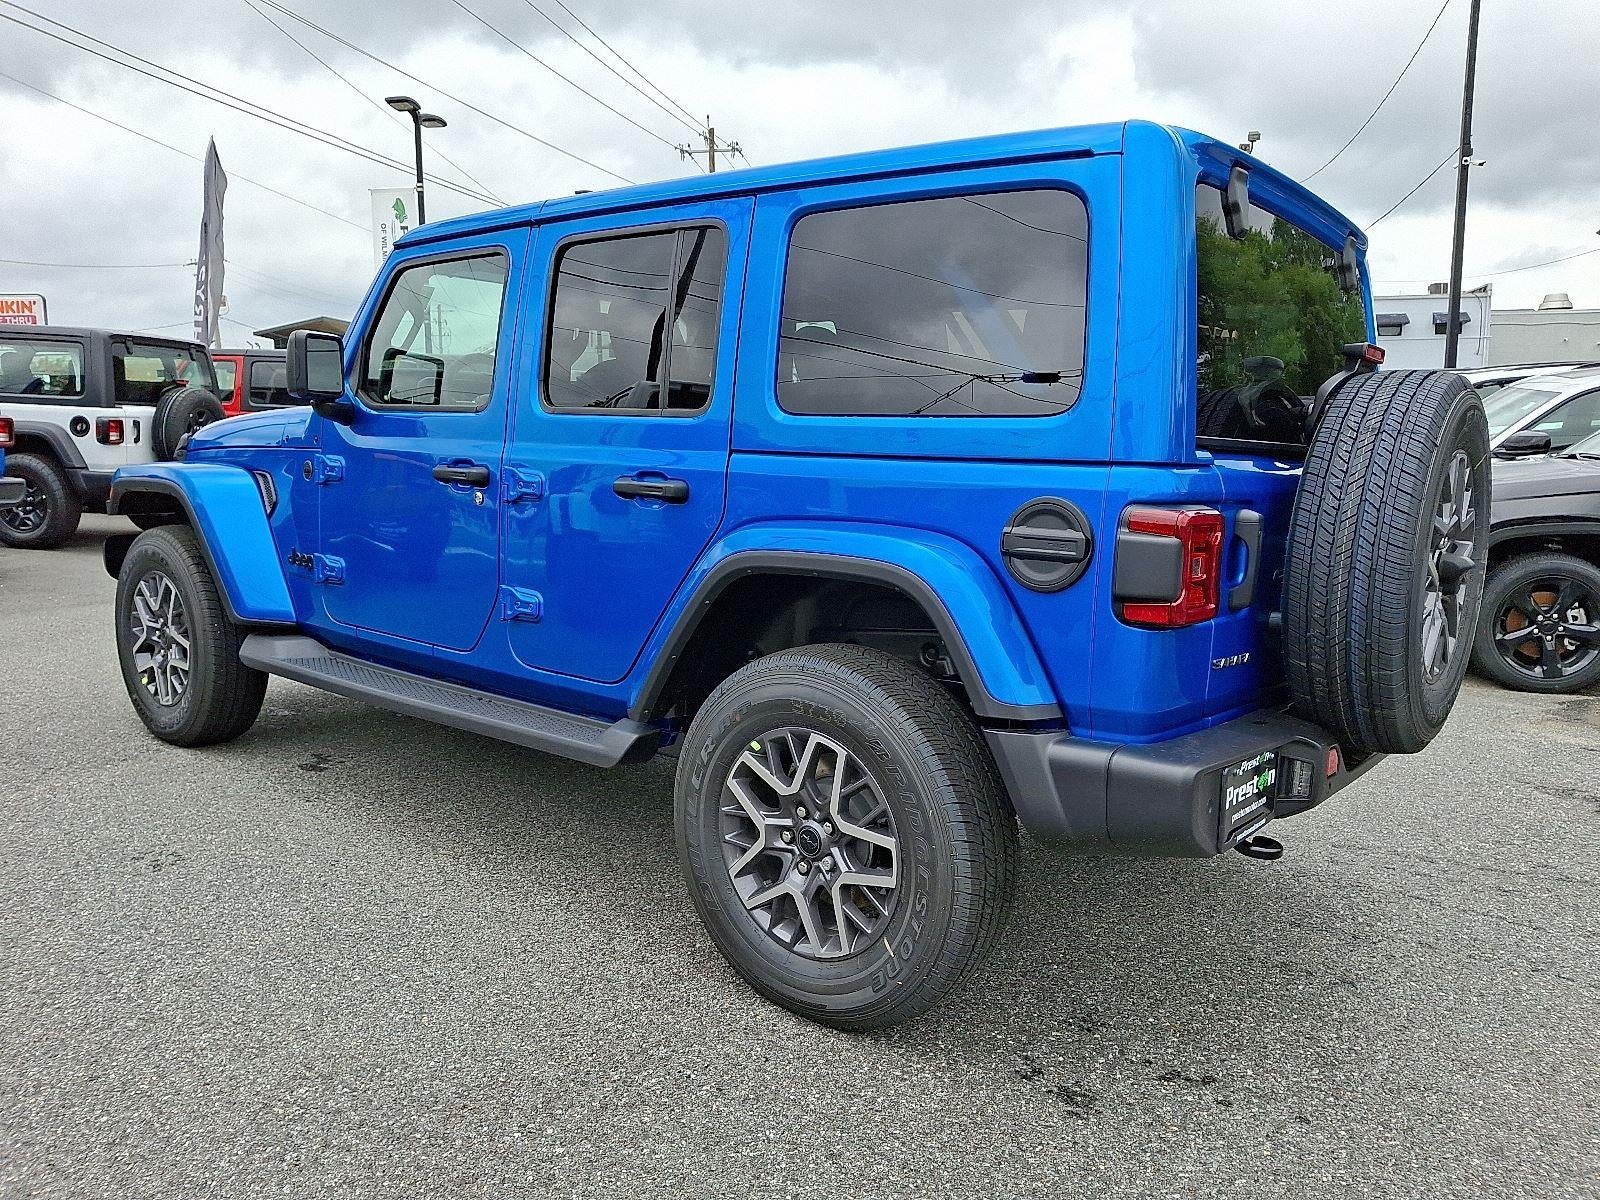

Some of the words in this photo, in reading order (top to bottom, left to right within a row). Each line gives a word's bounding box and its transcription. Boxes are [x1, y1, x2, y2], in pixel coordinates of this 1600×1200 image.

[380, 223, 387, 234] OF
[288, 546, 314, 573] Jeep
[1226, 768, 1276, 810] Preston
[866, 738, 931, 993] BRIDGESTONE
